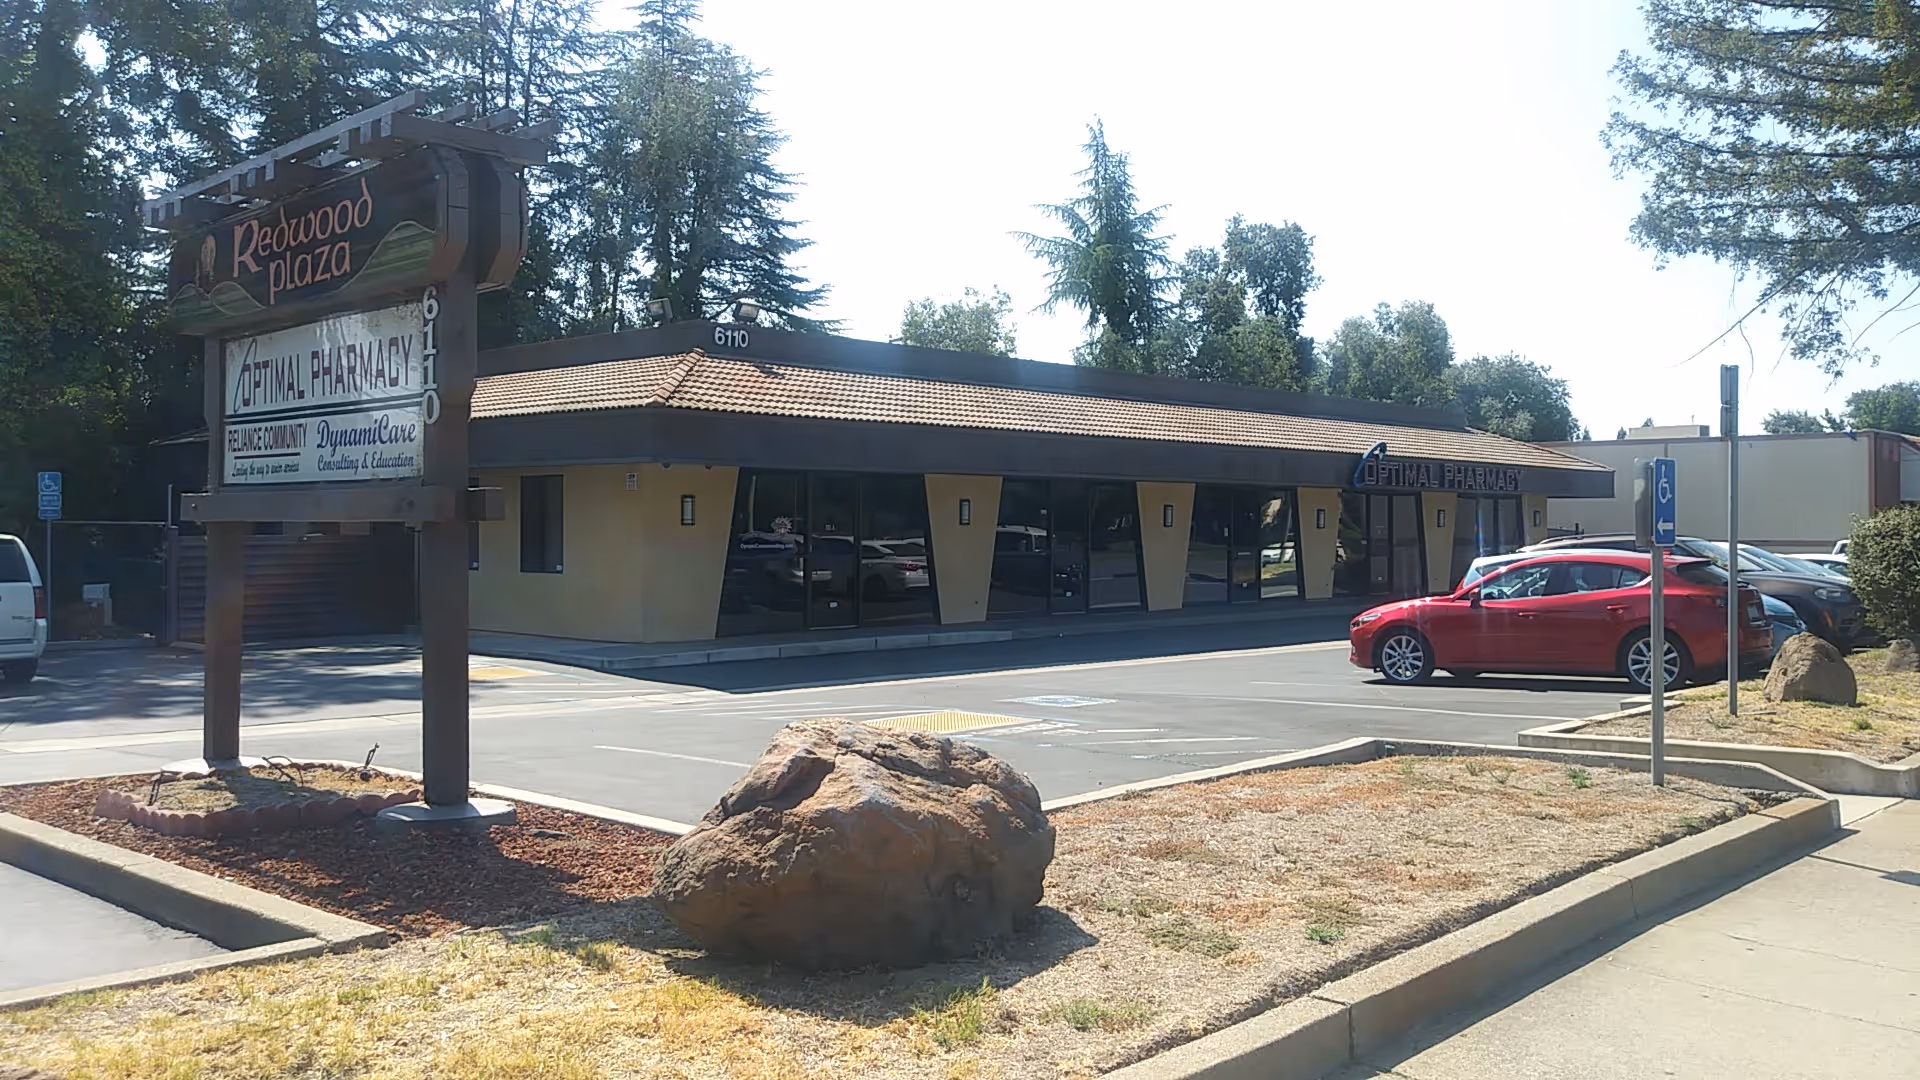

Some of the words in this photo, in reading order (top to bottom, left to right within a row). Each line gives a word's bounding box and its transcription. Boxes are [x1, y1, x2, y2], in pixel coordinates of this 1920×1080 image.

[233, 177, 373, 278] Redwood
[269, 241, 351, 305] plaza
[423, 285, 440, 424] 6110
[714, 326, 749, 348] 6110
[239, 350, 305, 409] OPTIMAL
[311, 334, 412, 398] PHARMACY
[228, 427, 262, 453] RELIANCE
[263, 422, 307, 450] COMMUNITY
[316, 413, 417, 458] DynamiCare
[317, 453, 360, 476] Consulting
[361, 451, 369, 469] &
[370, 450, 415, 469] Education
[1362, 456, 1439, 488] OPTIMAL
[1444, 463, 1523, 491] PHARMACY
